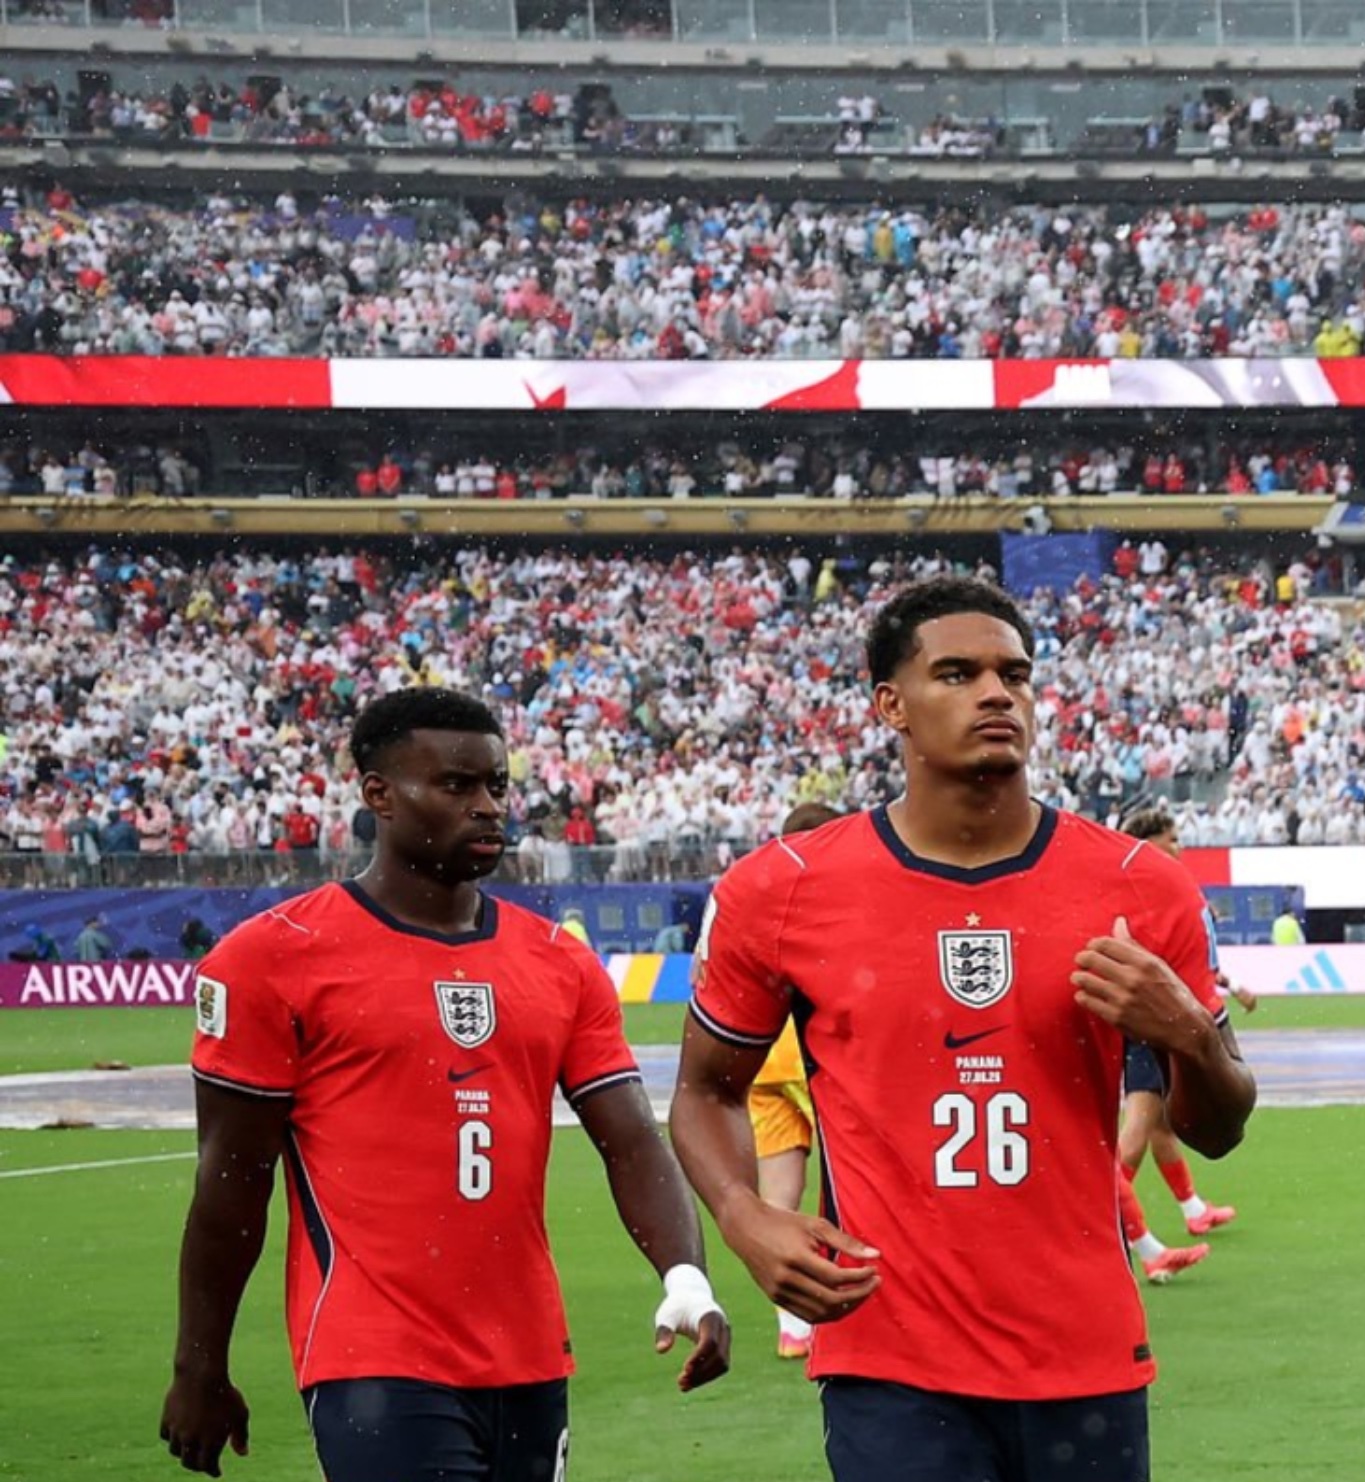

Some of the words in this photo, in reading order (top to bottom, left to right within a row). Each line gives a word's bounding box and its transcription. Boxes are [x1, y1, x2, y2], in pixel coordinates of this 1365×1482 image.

[19, 963, 197, 1004] AIRWAY
[458, 1119, 493, 1201] 6
[932, 1091, 1030, 1187] 26
